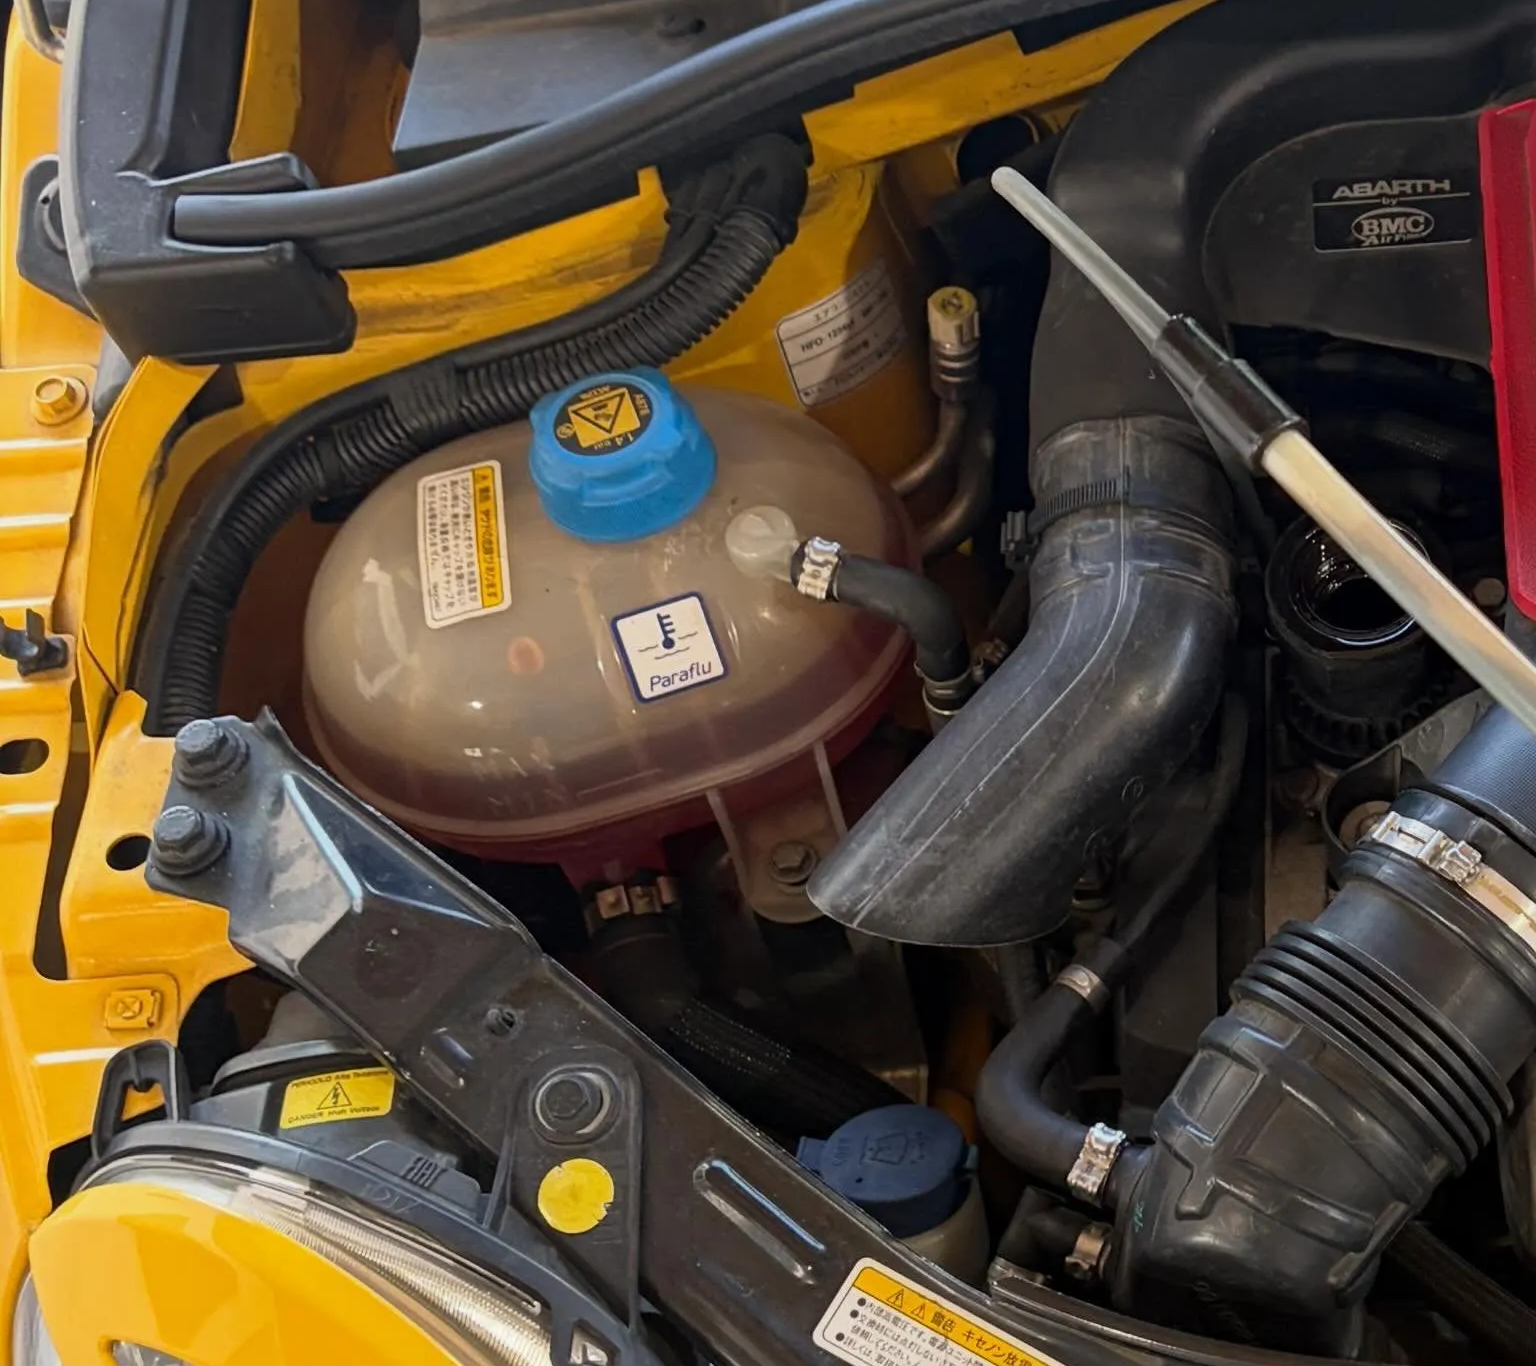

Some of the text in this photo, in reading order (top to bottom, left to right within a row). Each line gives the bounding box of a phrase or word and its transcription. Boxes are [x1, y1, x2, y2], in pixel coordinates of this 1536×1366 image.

[1332, 179, 1450, 200] ABARTH
[1382, 196, 1398, 206] by
[1360, 216, 1425, 236] BMC
[650, 661, 712, 692] Paraflu
[928, 1310, 958, 1335] 警告
